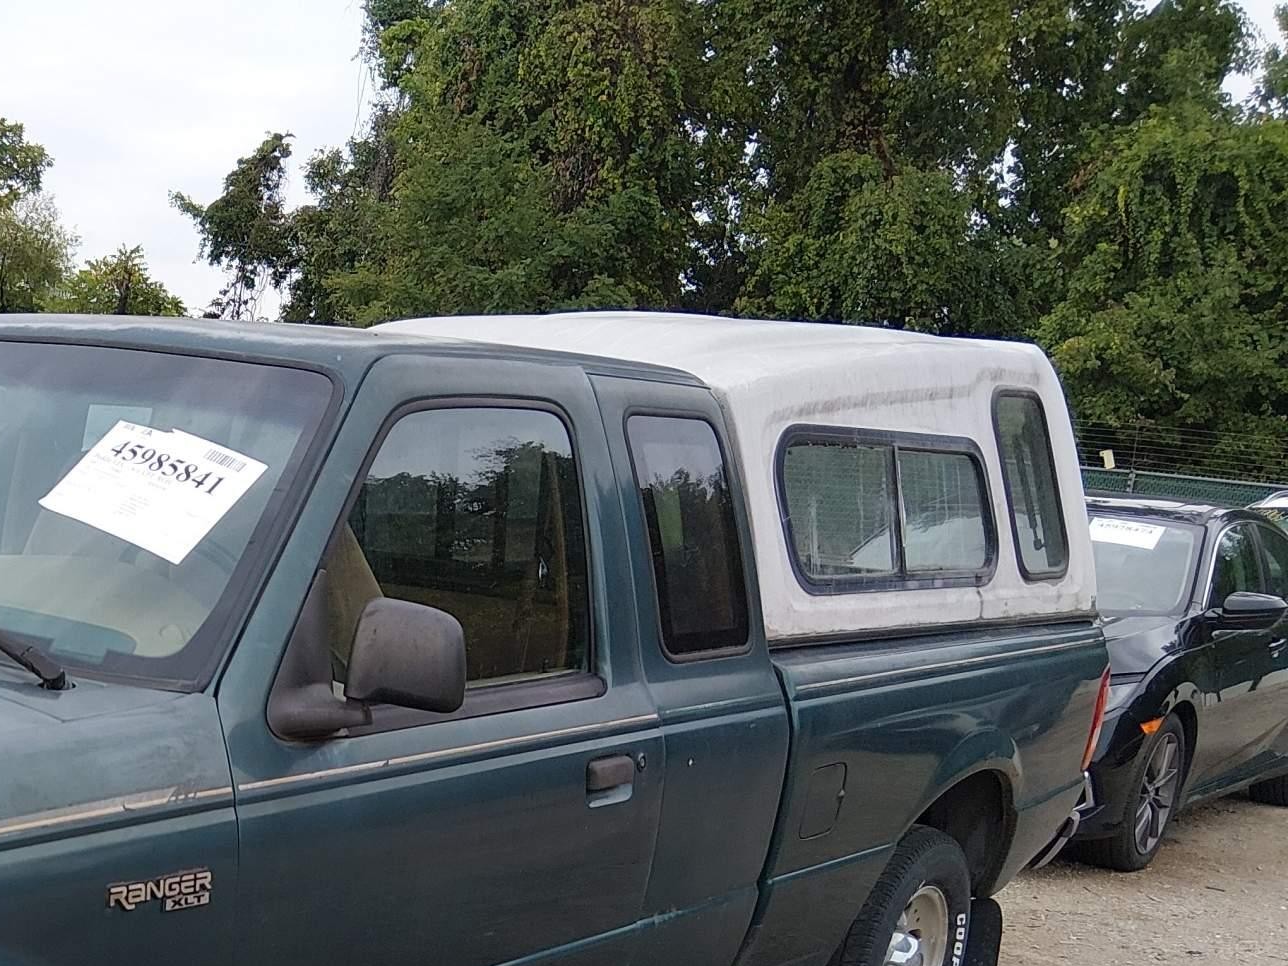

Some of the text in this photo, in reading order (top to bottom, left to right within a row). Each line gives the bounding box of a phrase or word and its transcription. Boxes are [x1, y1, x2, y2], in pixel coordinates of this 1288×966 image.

[111, 440, 224, 496] 45985841
[109, 871, 212, 911] RANGER
[170, 894, 207, 909] XLT
